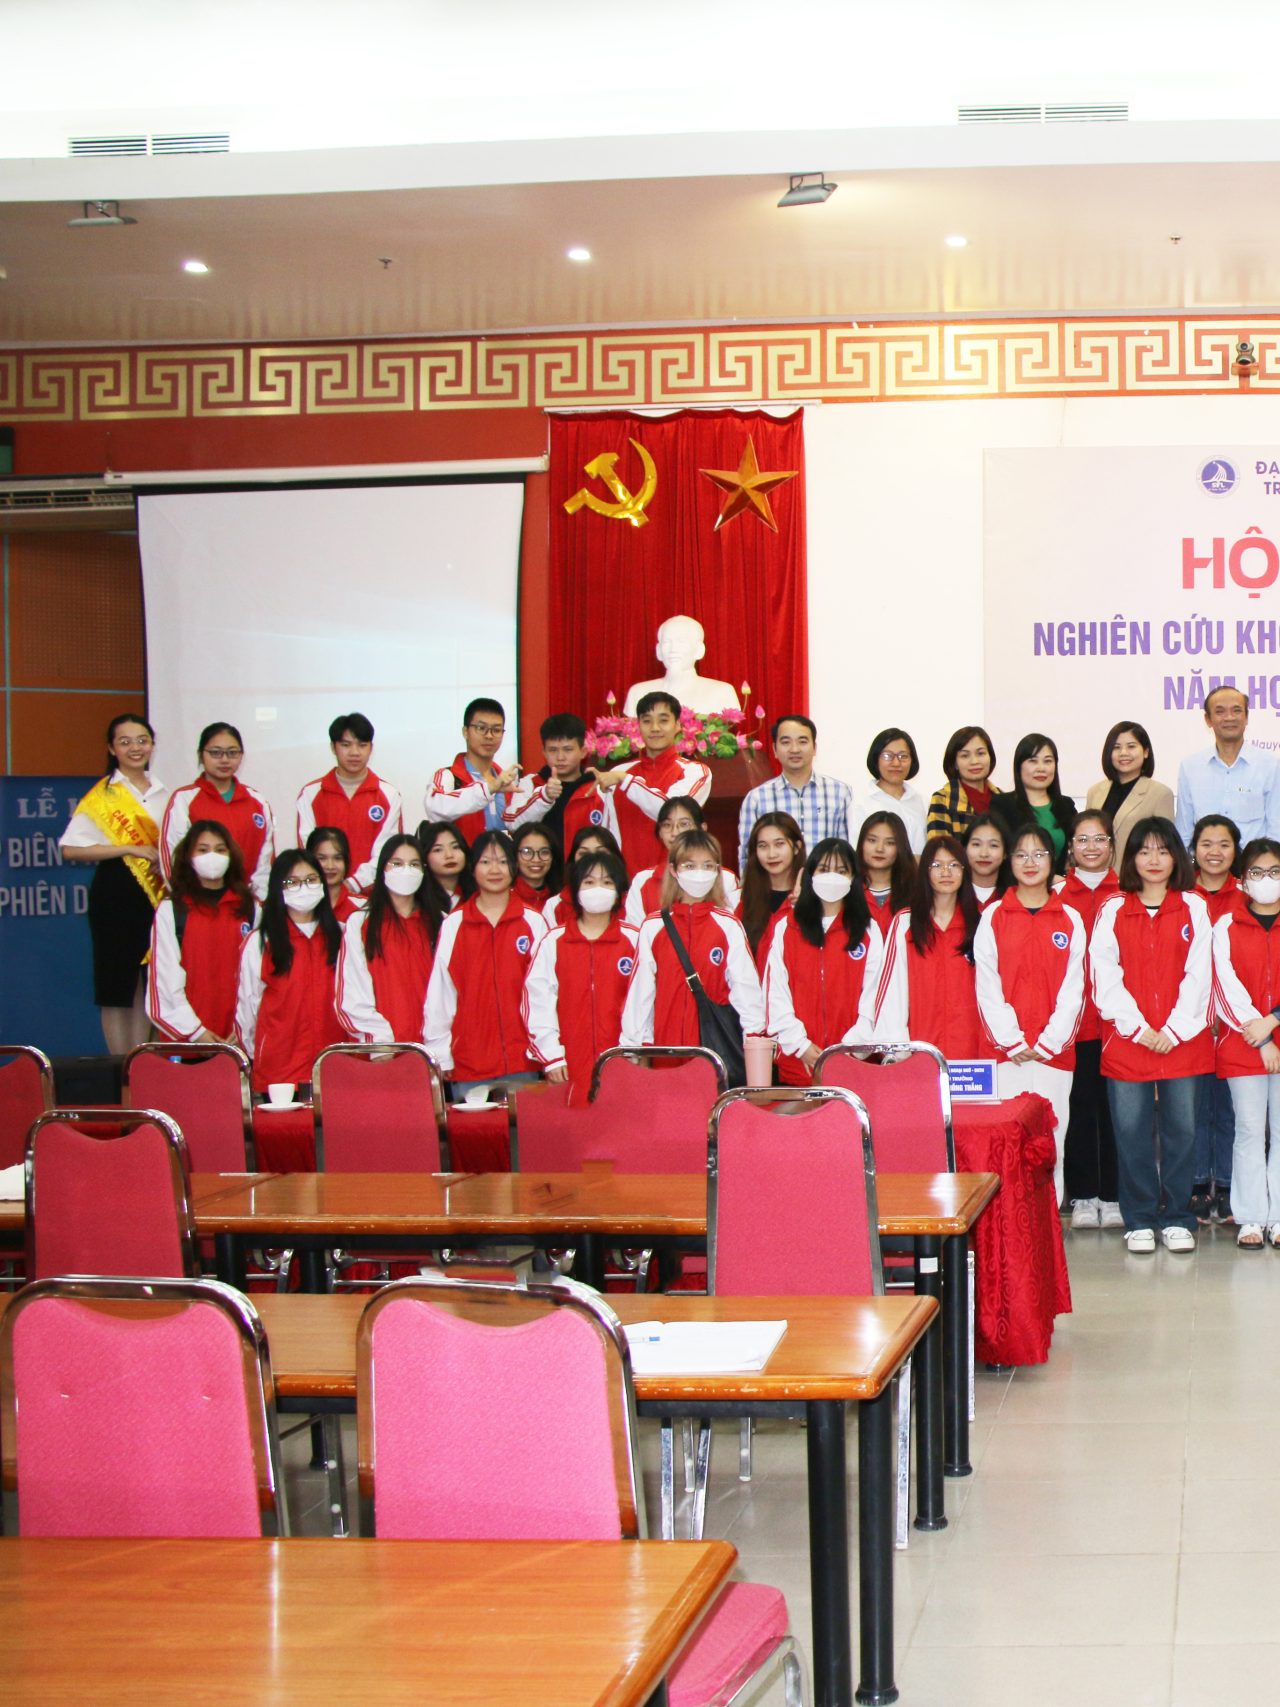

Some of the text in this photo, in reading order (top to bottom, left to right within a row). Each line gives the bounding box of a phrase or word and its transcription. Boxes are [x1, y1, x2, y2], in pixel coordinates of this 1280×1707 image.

[1033, 614, 1151, 656] NGHIÊN
[1162, 613, 1225, 655] CỨU
[16, 787, 59, 819] LỄ
[8, 832, 63, 868] BIÊN
[0, 880, 67, 917] PHIÊN
